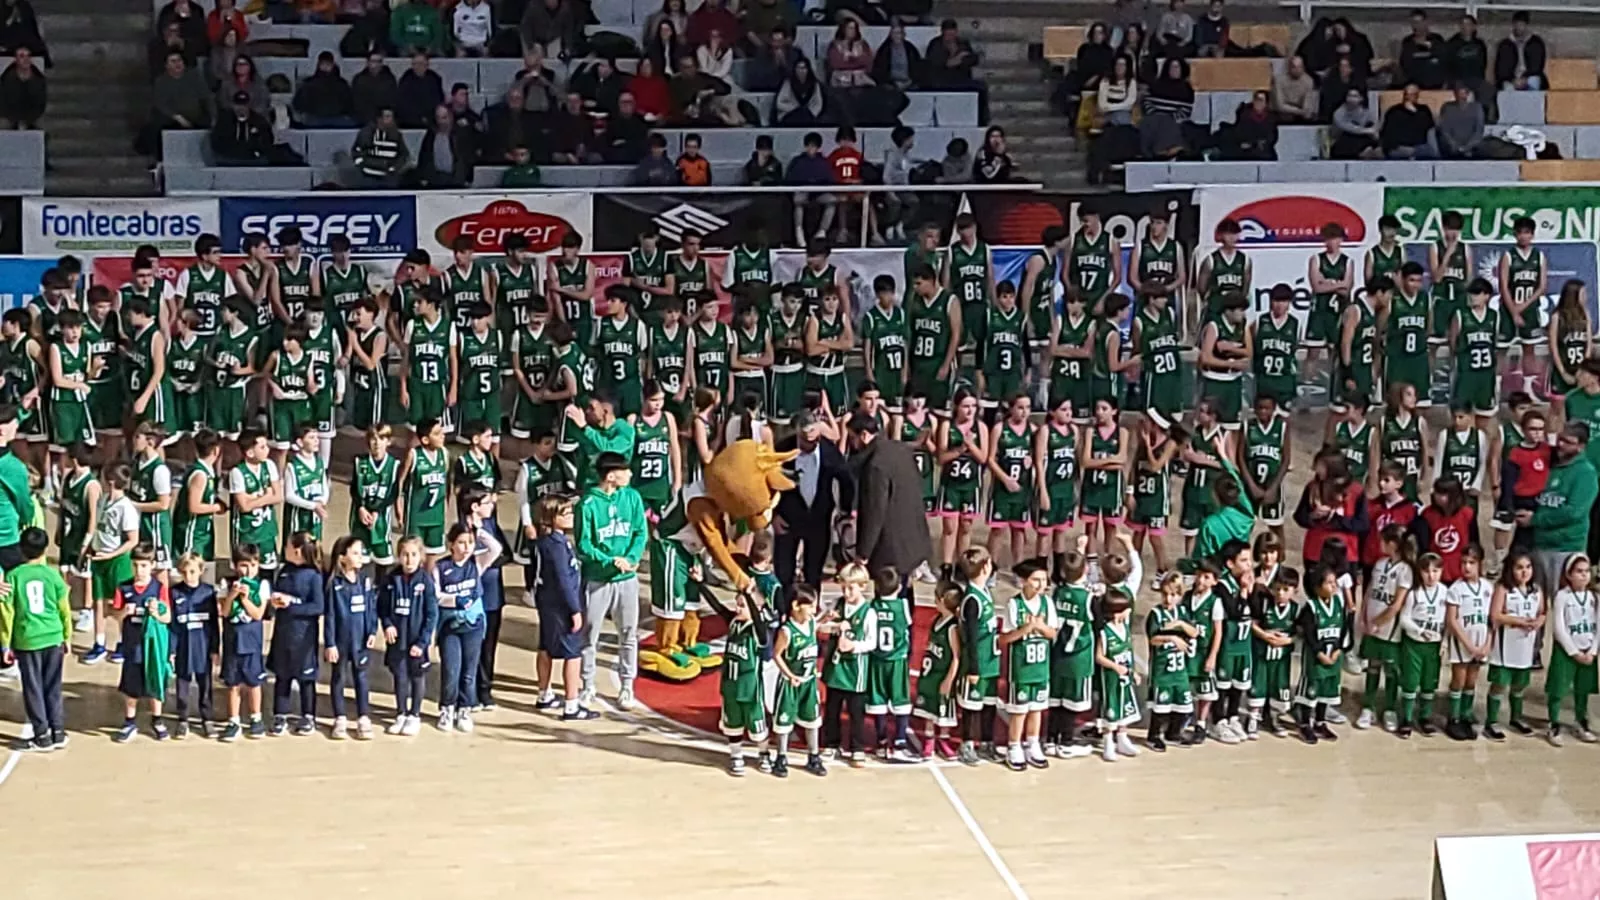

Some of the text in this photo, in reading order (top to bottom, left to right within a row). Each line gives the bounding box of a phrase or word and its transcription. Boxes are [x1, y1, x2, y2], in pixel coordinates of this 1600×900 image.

[241, 214, 400, 246] SERFEY
[1080, 271, 1098, 291] 17
[1406, 332, 1416, 352] 8
[1000, 349, 1012, 370] 3
[1154, 352, 1176, 373] 20
[1470, 348, 1492, 369] 33
[1567, 346, 1584, 365] 95
[421, 361, 439, 382] 13
[613, 359, 626, 380] 3
[705, 368, 720, 387] 17
[480, 371, 491, 393] 5
[640, 458, 663, 478] 23
[950, 461, 972, 479] 34
[1194, 467, 1206, 488] 11
[1257, 463, 1268, 484] 9
[429, 488, 439, 507] 7
[1026, 642, 1046, 664] 88
[1166, 653, 1185, 673] 33
[922, 657, 933, 677] 9
